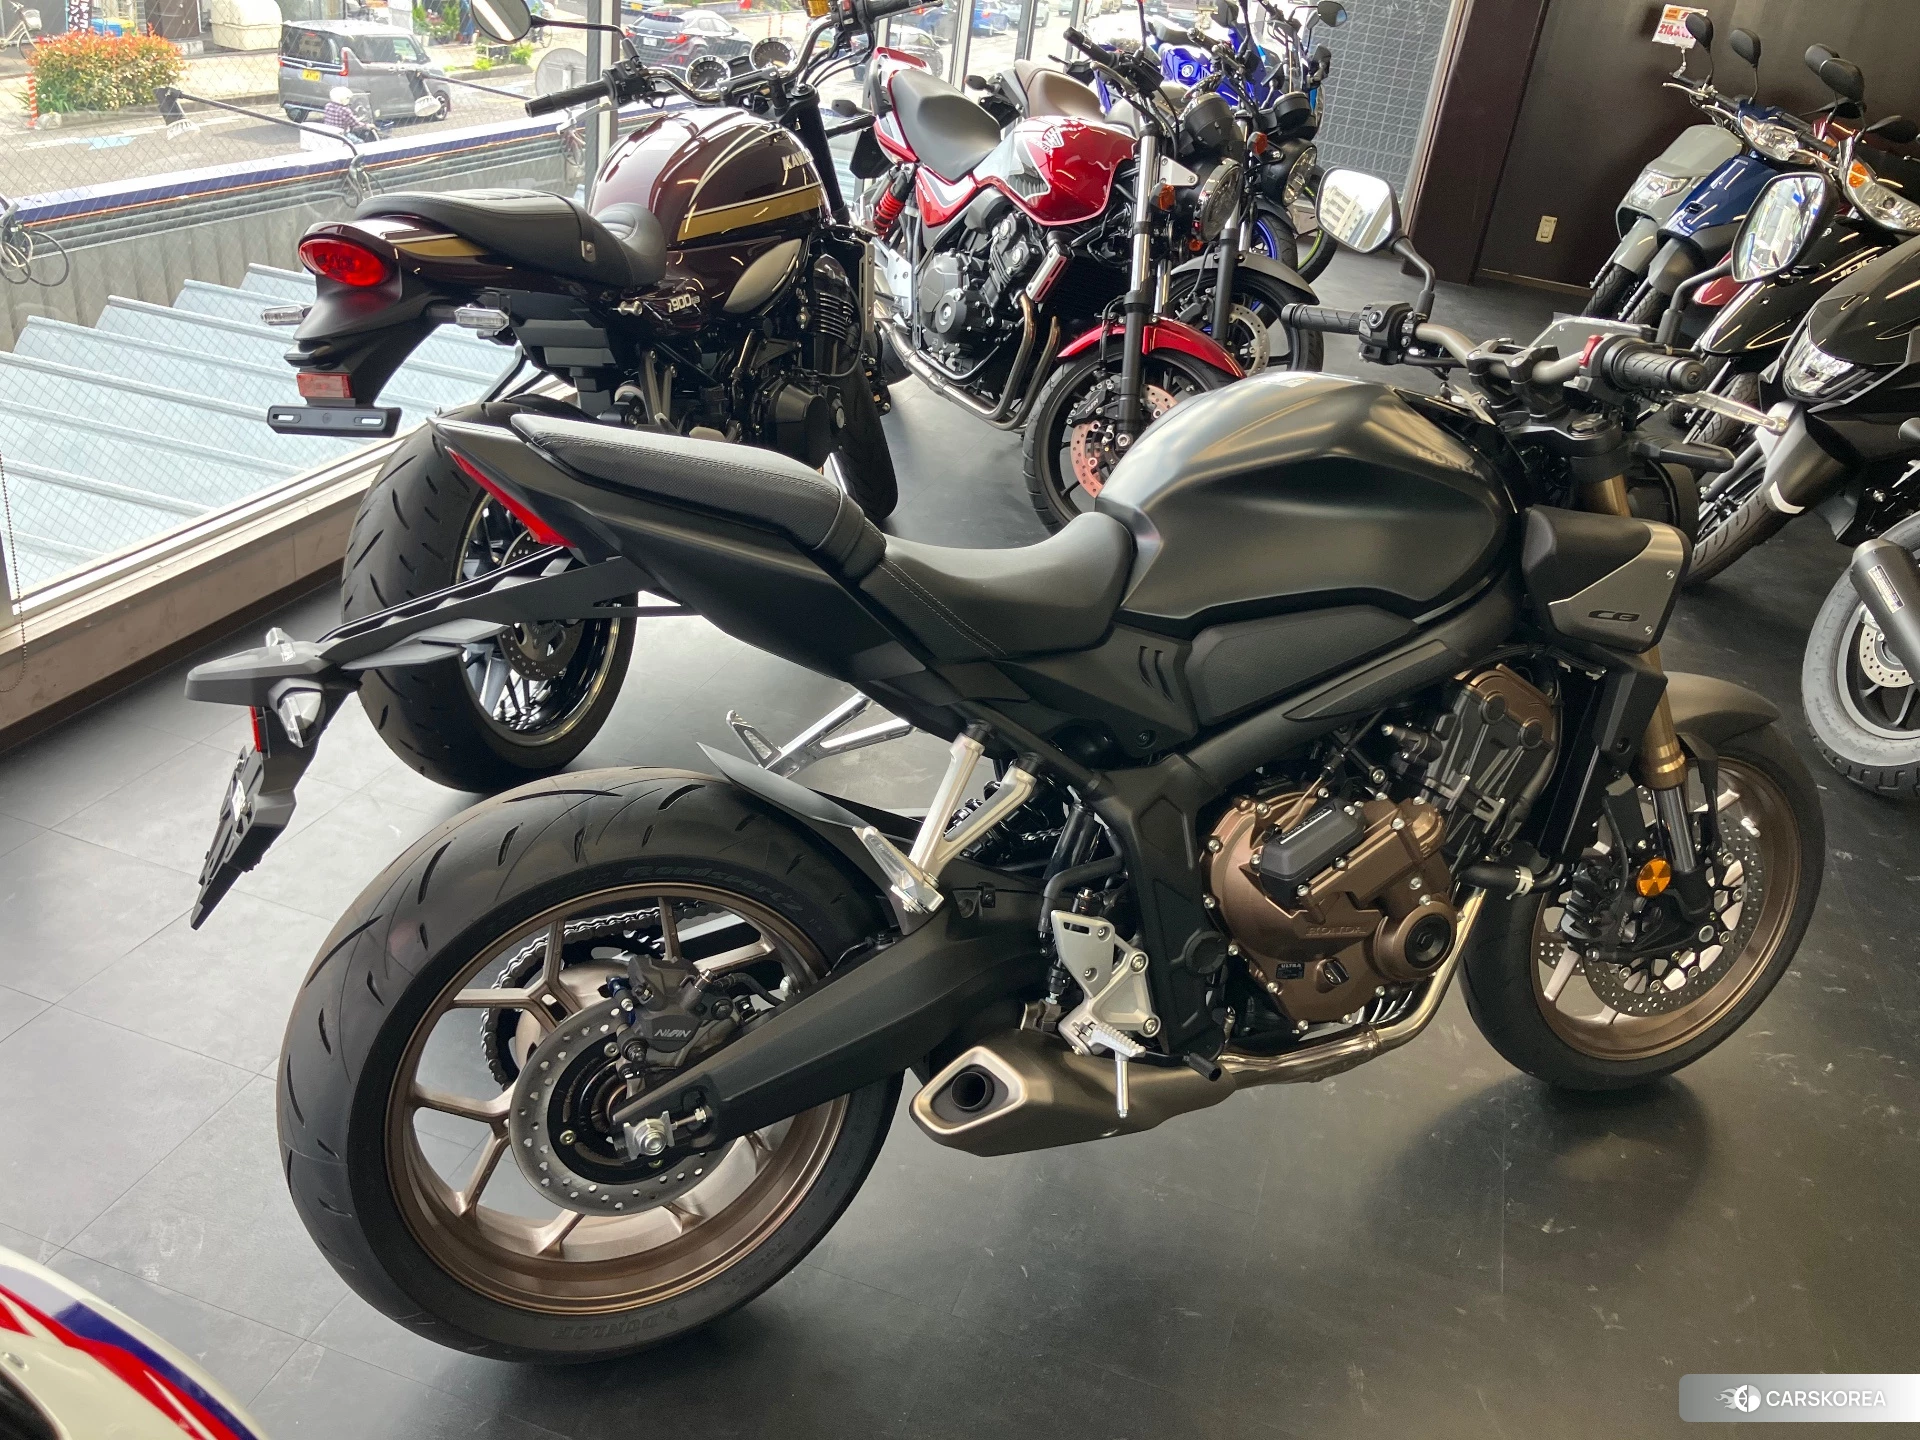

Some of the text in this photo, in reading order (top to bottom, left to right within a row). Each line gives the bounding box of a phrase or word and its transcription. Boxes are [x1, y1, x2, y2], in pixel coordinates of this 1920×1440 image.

[1416, 447, 1487, 482] HONDA
[1588, 609, 1641, 623] CB
[1305, 926, 1368, 937] HONDA
